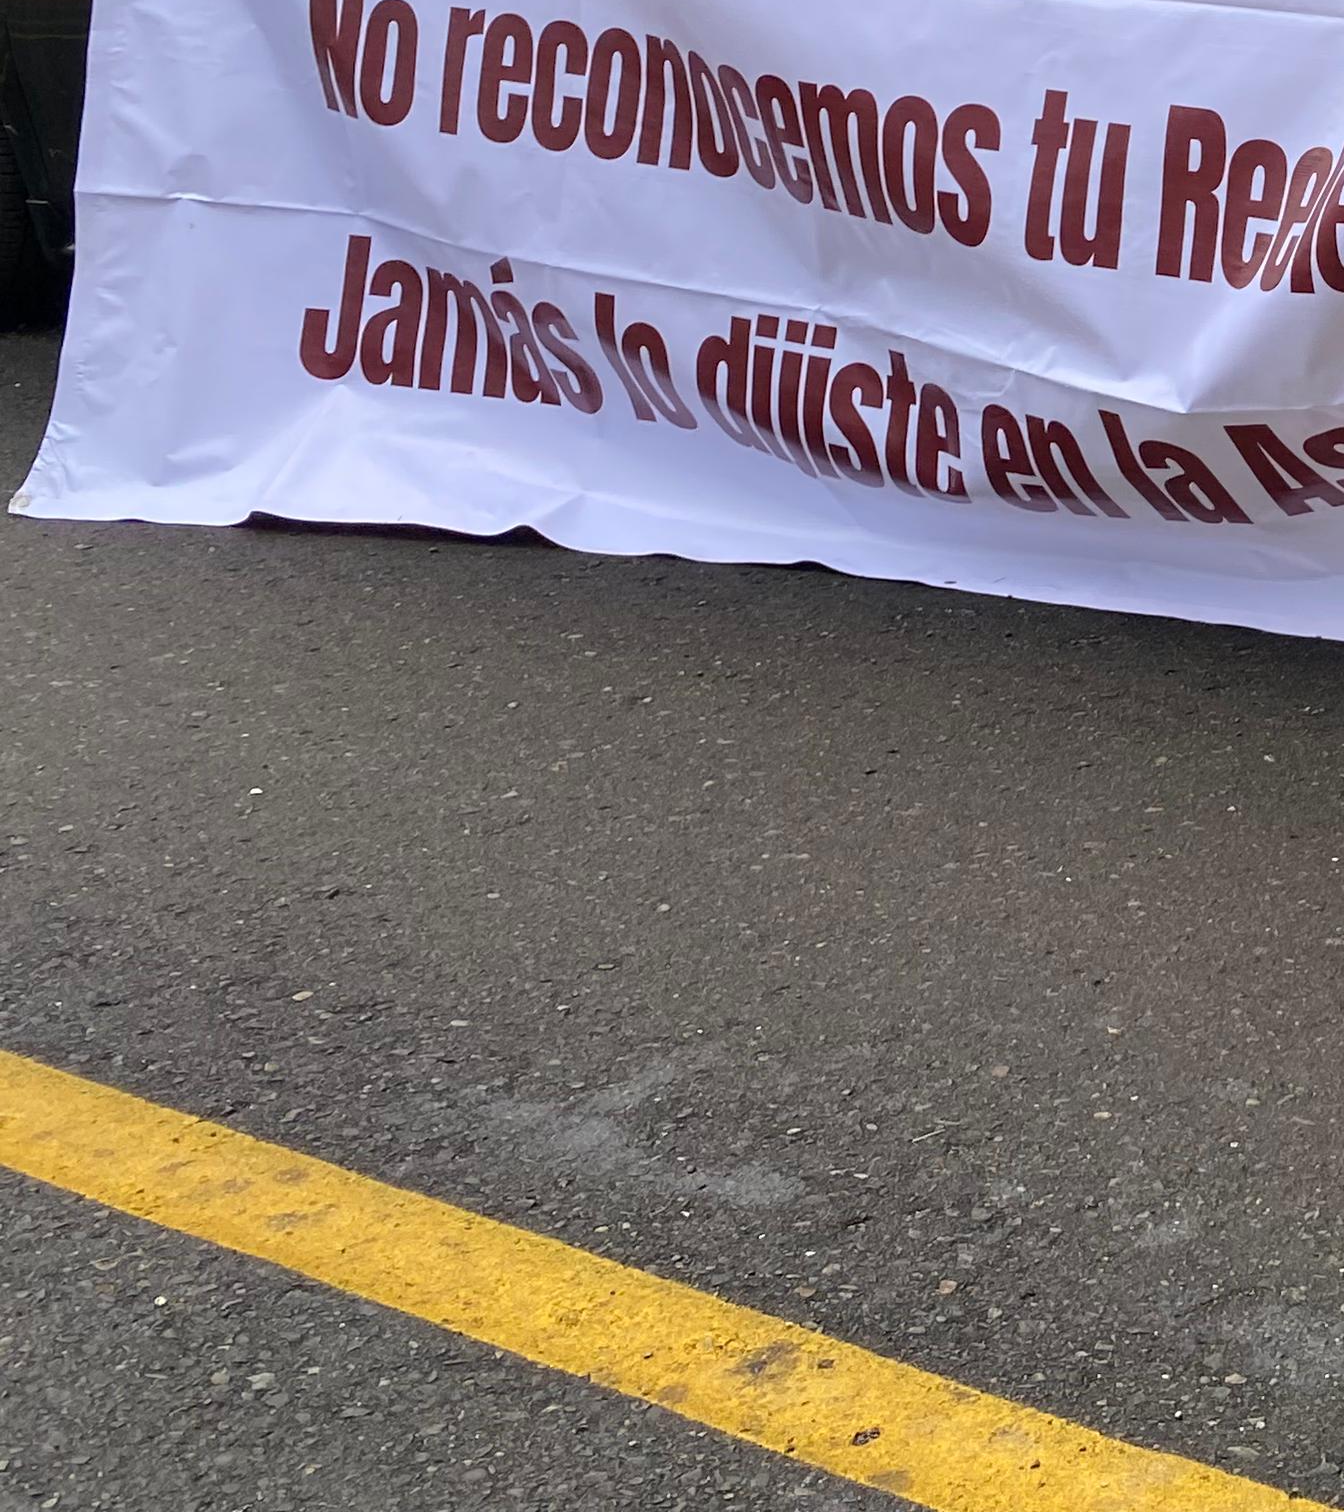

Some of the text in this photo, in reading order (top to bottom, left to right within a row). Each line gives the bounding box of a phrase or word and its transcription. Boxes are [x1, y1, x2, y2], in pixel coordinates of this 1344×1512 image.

[439, 6, 1001, 248] reconocemos
[1024, 89, 1132, 271] tu
[299, 234, 603, 415] Jamás
[595, 291, 699, 430] lo
[981, 403, 1132, 519] en
[1098, 409, 1255, 525] la
